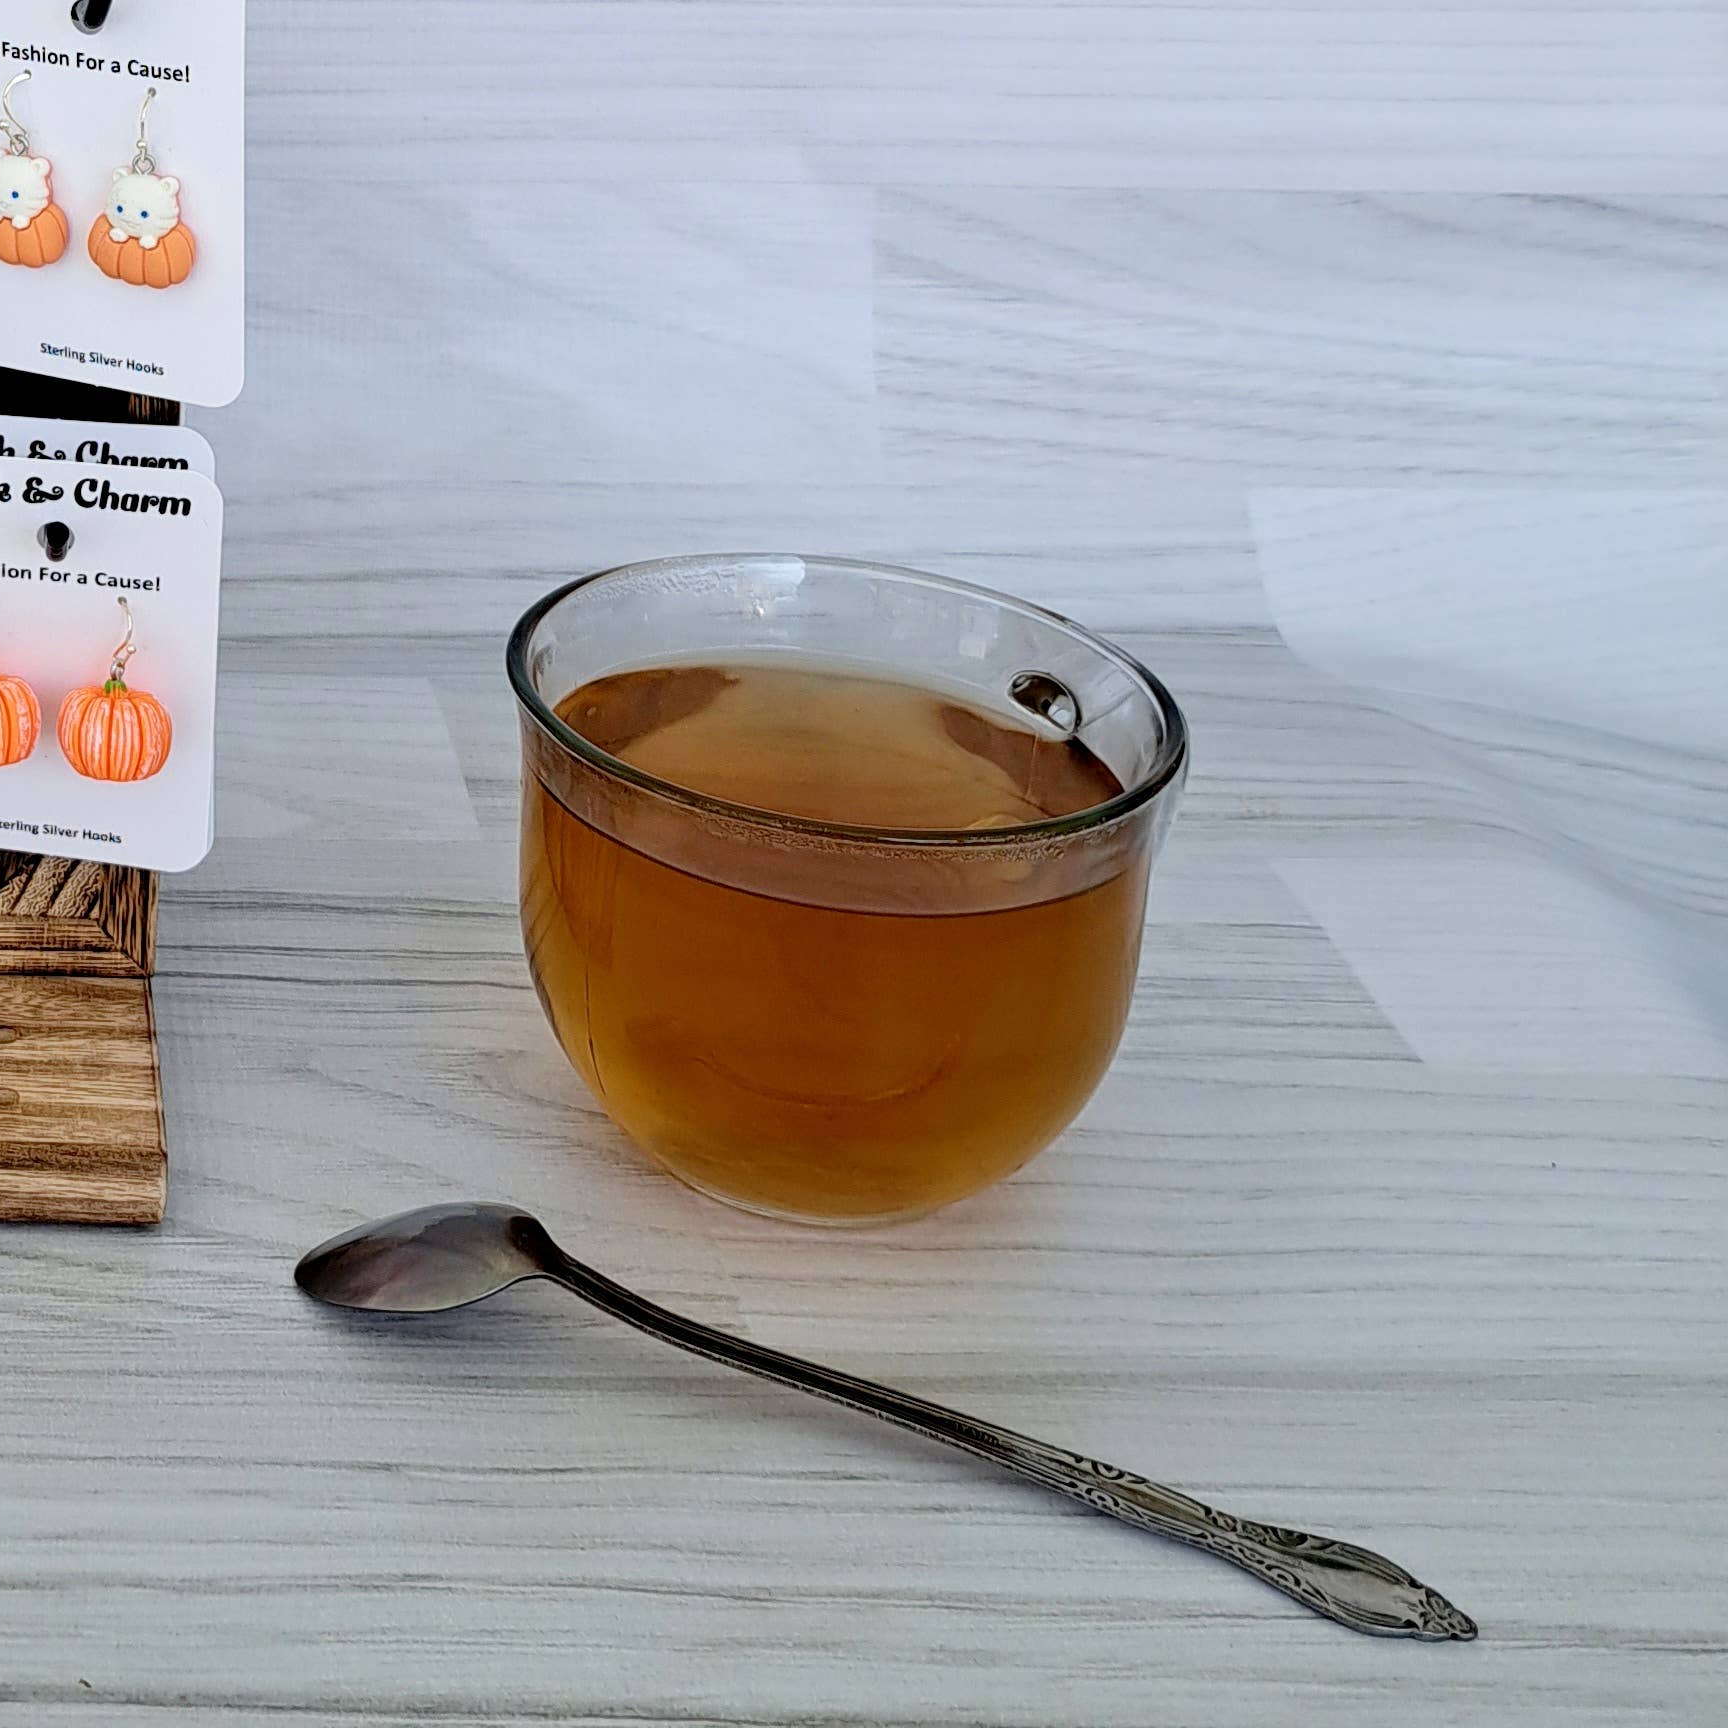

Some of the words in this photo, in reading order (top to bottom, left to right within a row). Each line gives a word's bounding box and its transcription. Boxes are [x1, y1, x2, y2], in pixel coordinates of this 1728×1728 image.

[1, 41, 70, 67] Fashion
[76, 51, 105, 72] For
[110, 60, 121, 74] a
[127, 59, 190, 83] Cause!
[40, 342, 86, 364] Sterling
[88, 351, 123, 368] Silver
[126, 359, 165, 376] Hooks
[21, 476, 65, 504] &
[73, 478, 192, 517] Charm
[39, 566, 72, 583] For
[76, 573, 88, 585] a
[94, 572, 161, 592] Cause!
[42, 823, 79, 838] Silver
[82, 829, 122, 844] Hooks
